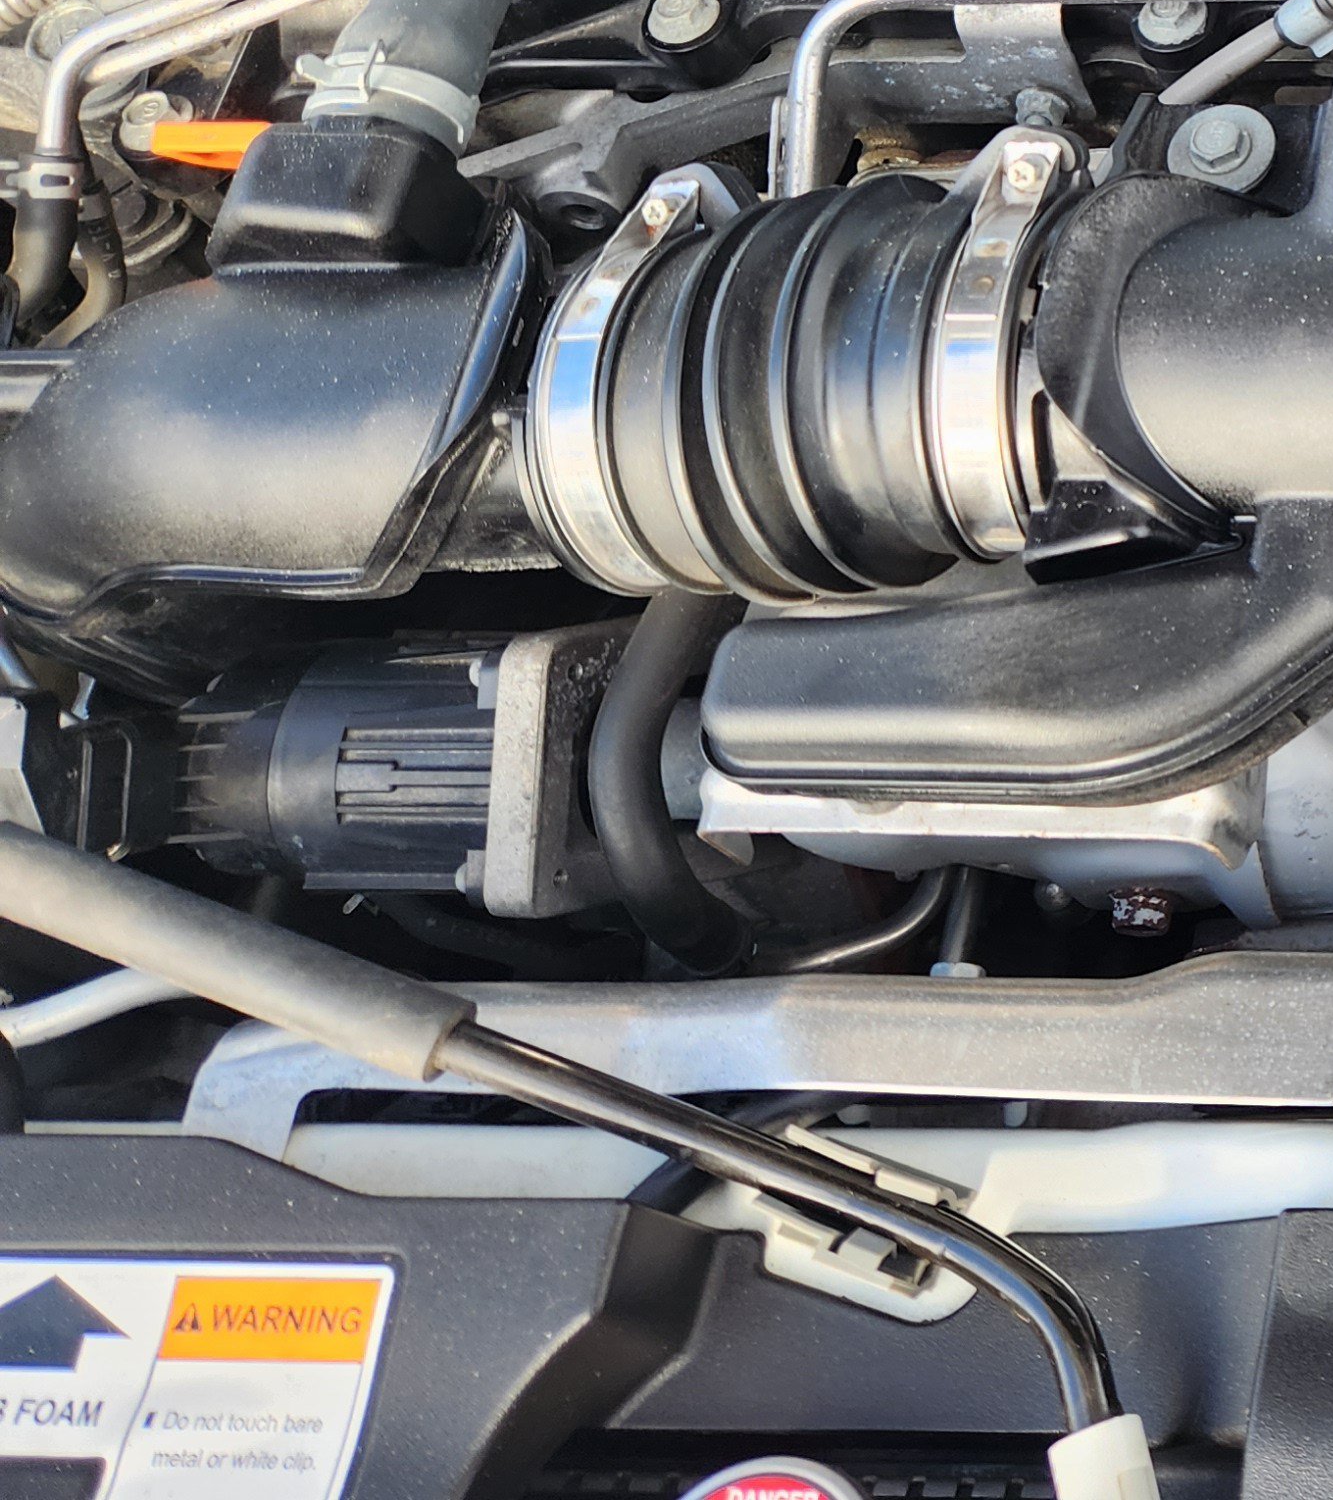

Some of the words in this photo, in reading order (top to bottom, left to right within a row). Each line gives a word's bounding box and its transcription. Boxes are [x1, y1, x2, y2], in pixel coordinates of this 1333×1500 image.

[208, 1302, 364, 1337] WARNING
[13, 1398, 105, 1427] FOAM
[163, 1412, 190, 1433] Do
[195, 1413, 224, 1434] not
[226, 1412, 279, 1435] touch
[283, 1413, 323, 1435] bare
[151, 1447, 203, 1469] metal
[207, 1452, 227, 1470] or
[230, 1449, 278, 1471] white
[282, 1450, 317, 1473] clip.
